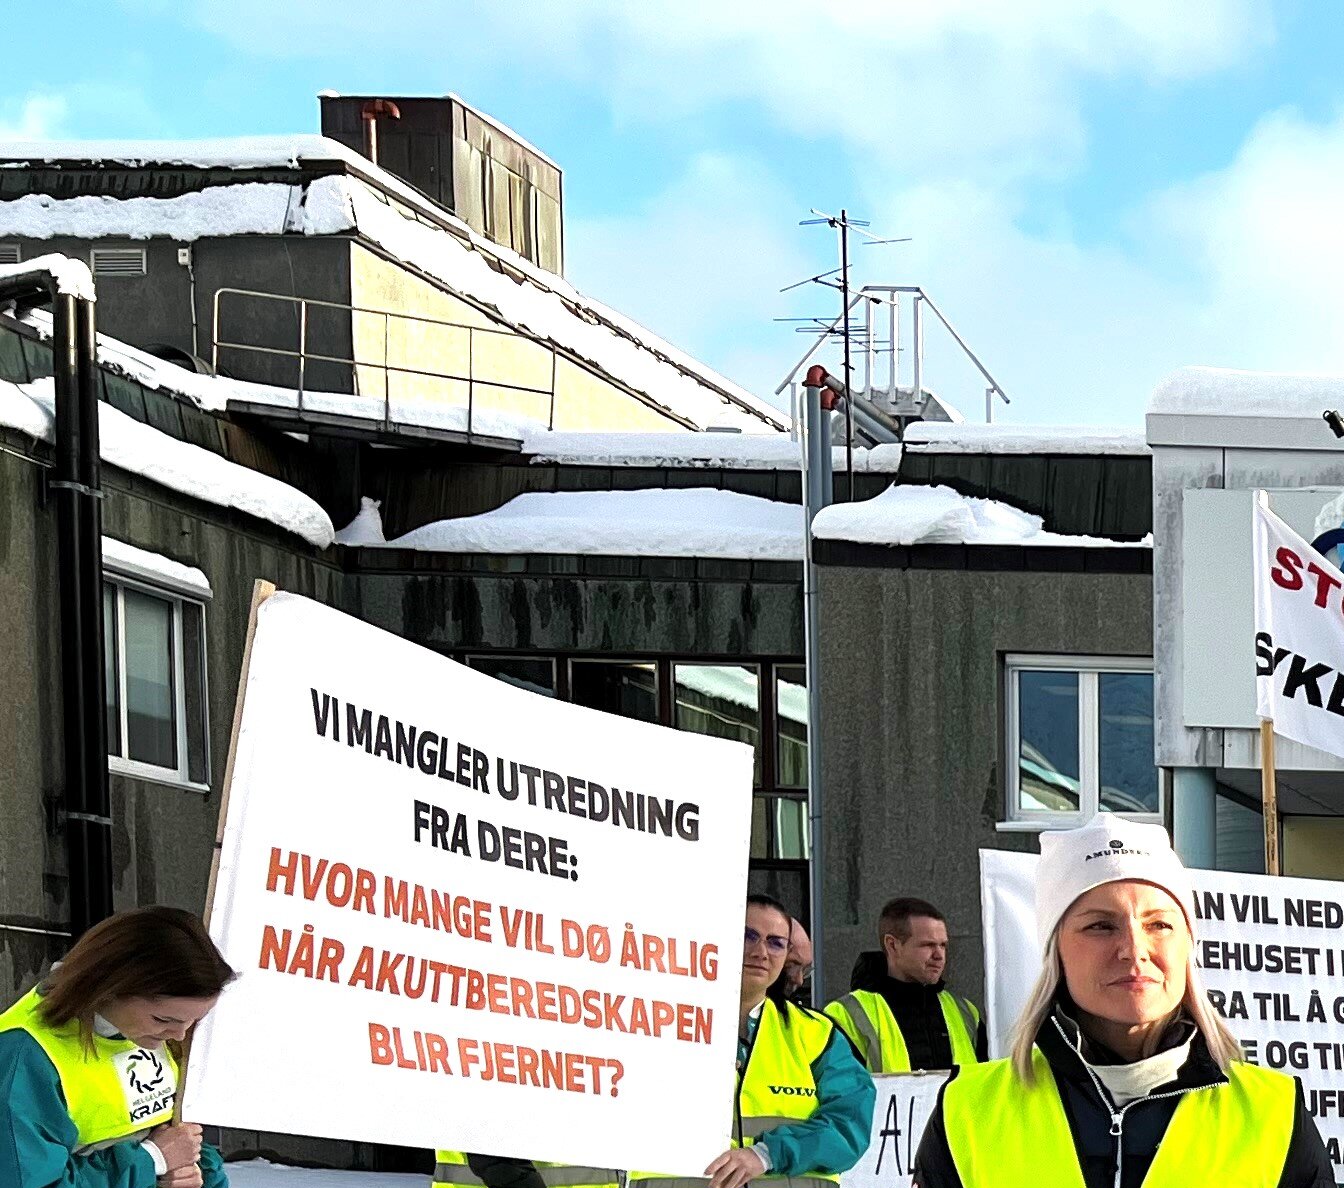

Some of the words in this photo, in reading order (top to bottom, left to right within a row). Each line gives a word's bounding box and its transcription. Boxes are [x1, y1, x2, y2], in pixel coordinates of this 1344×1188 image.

[311, 688, 339, 742] VI
[346, 703, 490, 794] MANGLER
[497, 757, 699, 841] UTREDNING
[414, 800, 471, 857] FRA
[478, 820, 578, 881] DERE:
[267, 848, 376, 914] HVOR
[384, 876, 491, 942] MANGE
[500, 906, 553, 953] VIL
[561, 920, 610, 963] DØ
[621, 923, 717, 981] ÅRLIG
[1230, 894, 1278, 924] VIL
[259, 925, 344, 983] NÅR
[349, 946, 714, 1045] AKUTTBEREDSKAPEN
[1196, 939, 1321, 978] EHUSET
[1327, 949, 1334, 976] I
[1253, 993, 1300, 1021] TIL
[1307, 990, 1327, 1023] Å
[369, 1023, 451, 1074] BLIR
[458, 1039, 624, 1097] FJERNET?
[1266, 1041, 1309, 1069] OG
